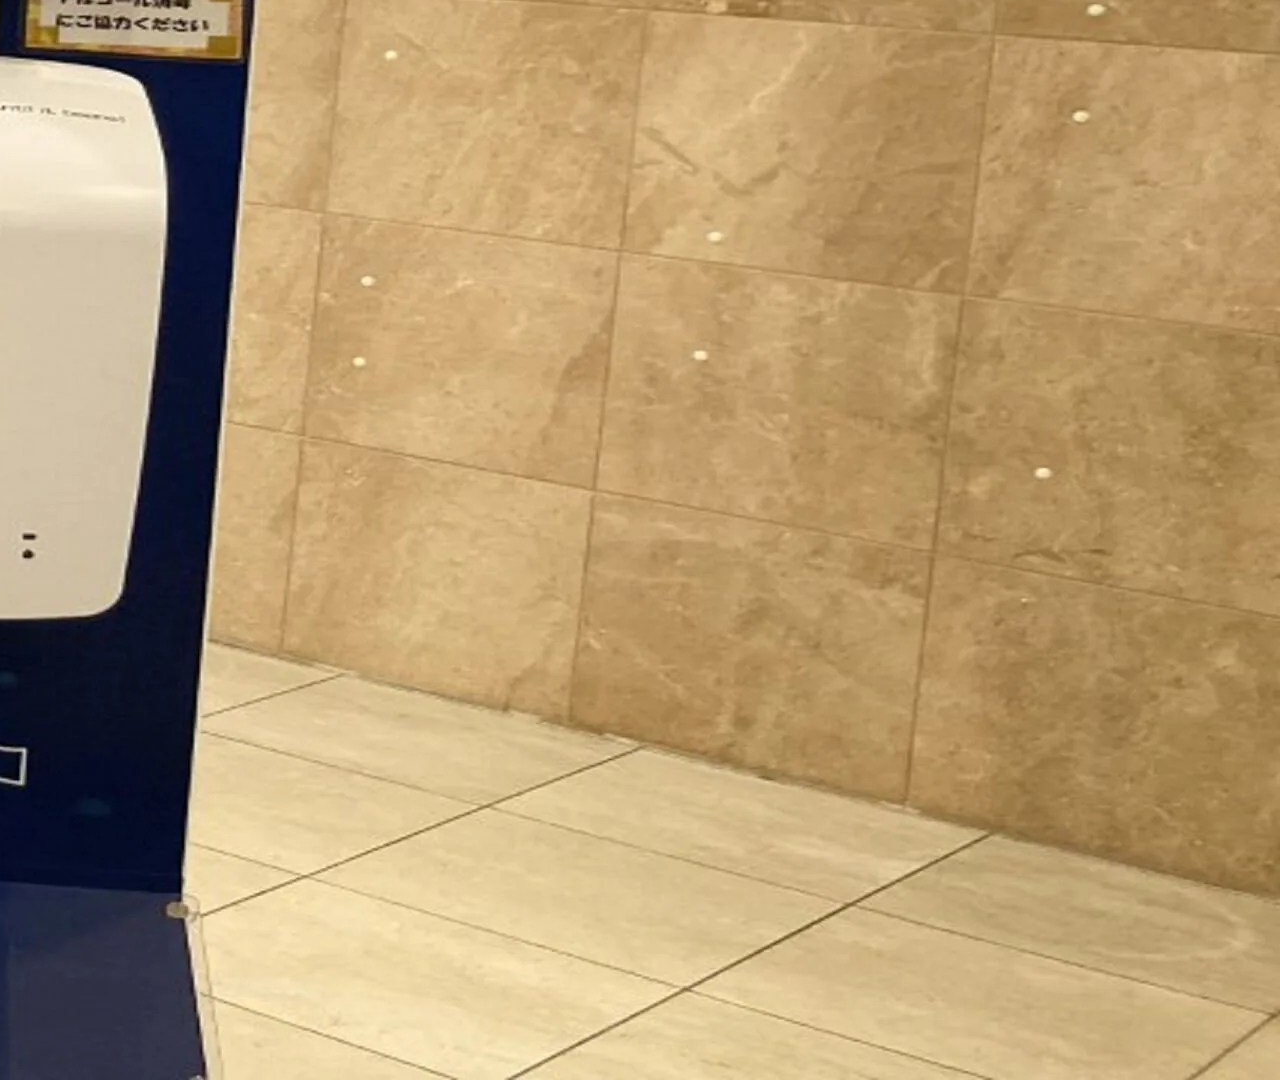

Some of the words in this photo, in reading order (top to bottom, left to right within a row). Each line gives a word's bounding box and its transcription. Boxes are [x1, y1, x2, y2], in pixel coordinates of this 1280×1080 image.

[55, 13, 210, 33] にご協力ください
